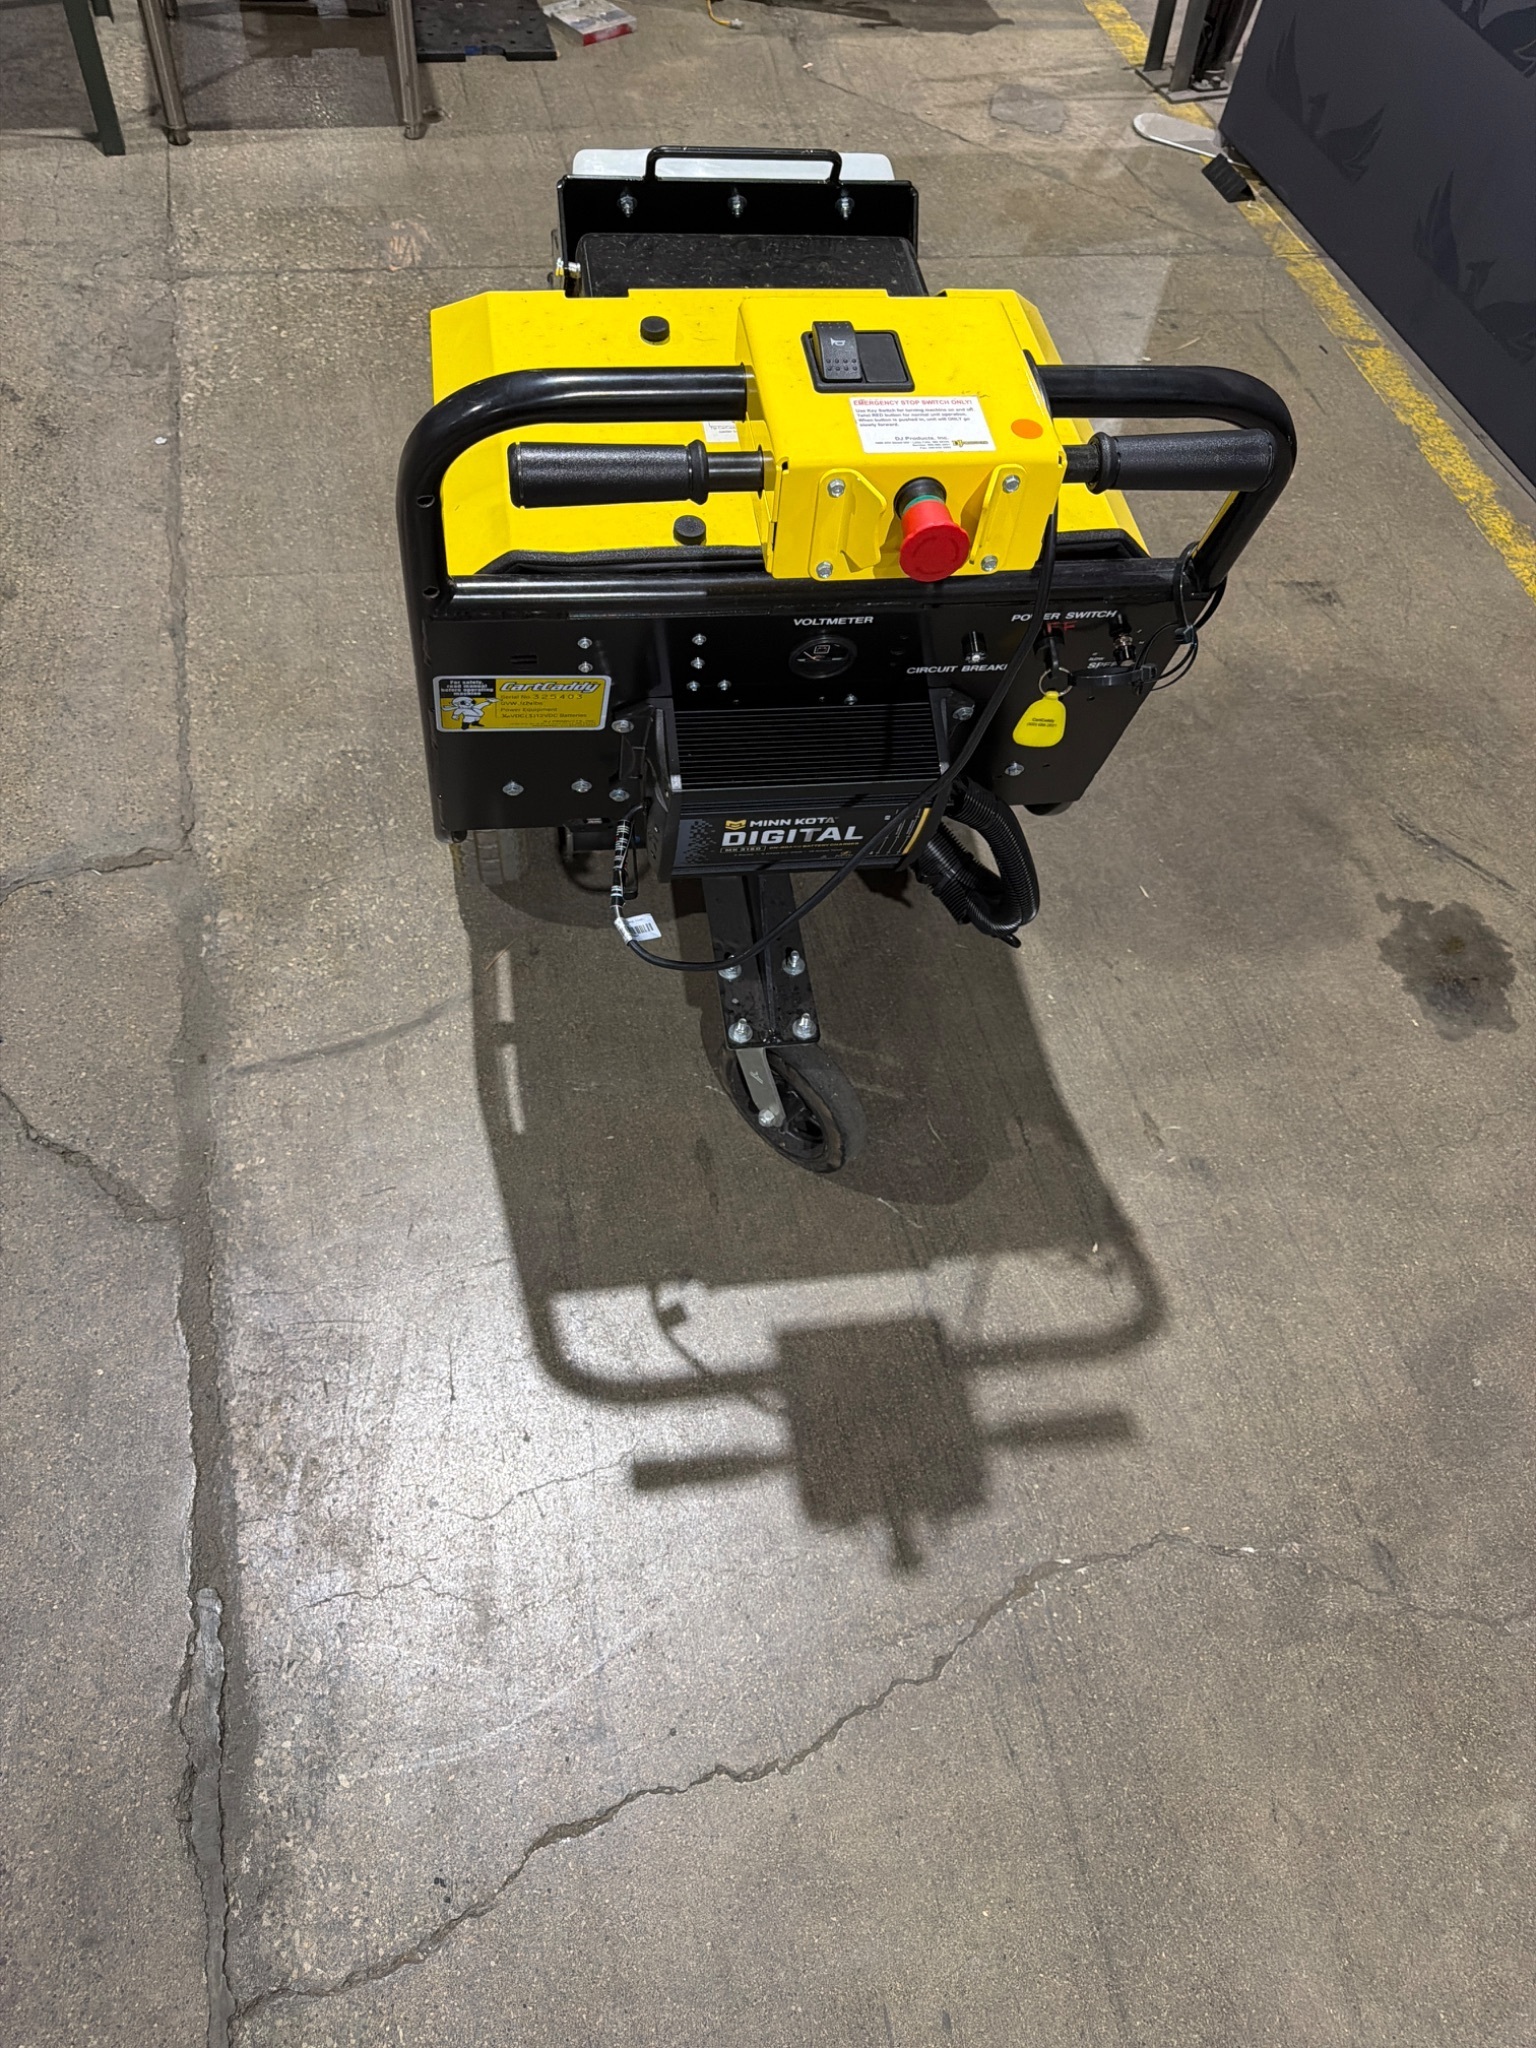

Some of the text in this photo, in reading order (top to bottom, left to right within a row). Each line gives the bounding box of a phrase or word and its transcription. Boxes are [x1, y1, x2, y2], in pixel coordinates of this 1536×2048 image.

[793, 616, 874, 626] VOLTMETER
[1011, 610, 1118, 622] POER SWITCH
[906, 663, 1008, 674] CIRCUIT BREAK
[500, 682, 601, 693] CartCaddy
[749, 817, 836, 828] MINN KOTA
[721, 826, 864, 846] DIGITAL
